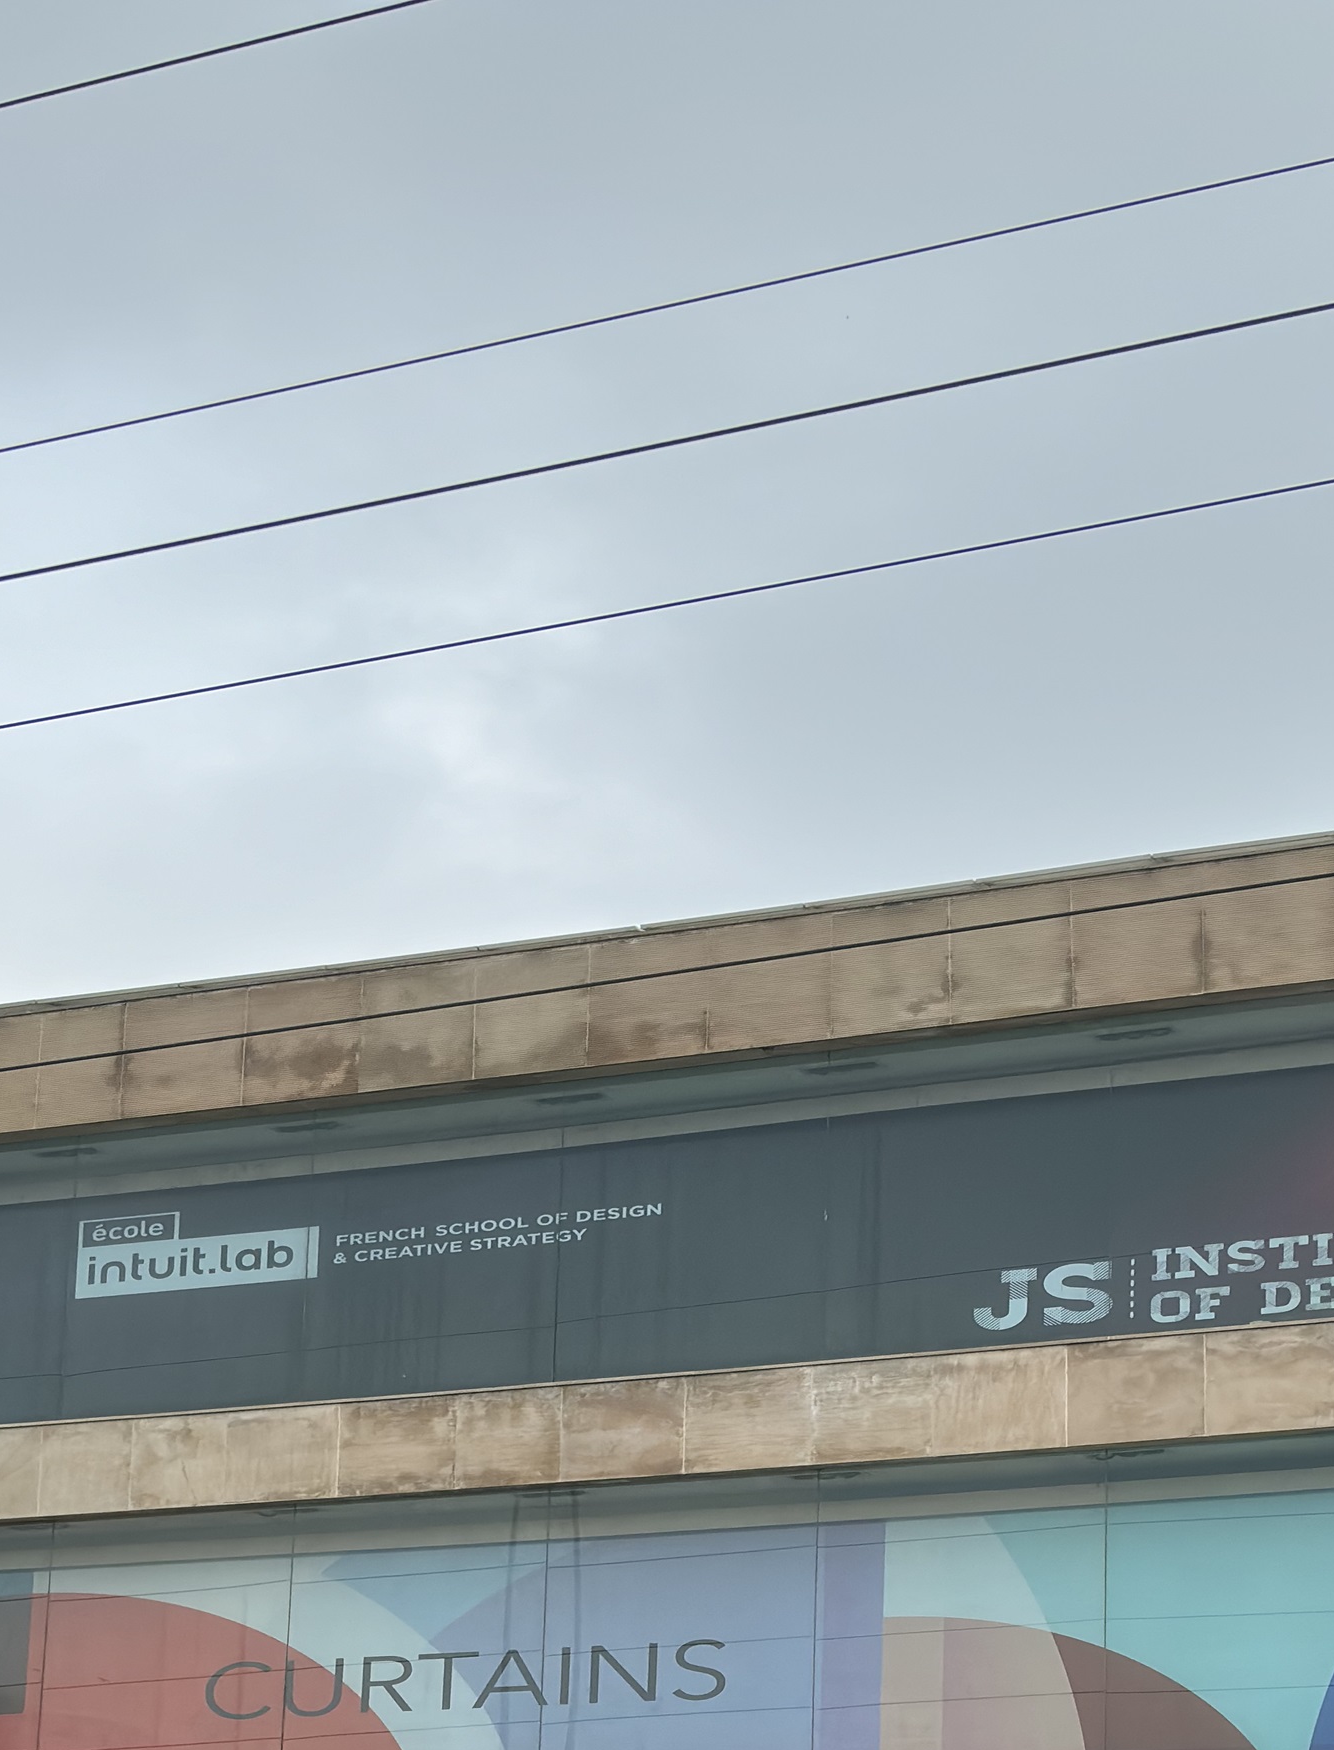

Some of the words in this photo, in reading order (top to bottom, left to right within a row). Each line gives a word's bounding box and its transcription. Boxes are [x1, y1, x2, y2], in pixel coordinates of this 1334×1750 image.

[92, 1221, 164, 1242] école
[333, 1252, 347, 1264] &
[354, 1240, 463, 1263] CREATIVE
[470, 1228, 588, 1251] STRATEGY
[336, 1226, 425, 1247] FRENCH
[435, 1217, 529, 1237] SCHOOL
[537, 1213, 569, 1226] OF
[576, 1203, 662, 1223] DESIGN
[87, 1240, 294, 1285] intuit.lab
[973, 1260, 1113, 1331] JS
[1150, 1286, 1230, 1324] OF
[205, 1639, 725, 1720] CURTAINS
